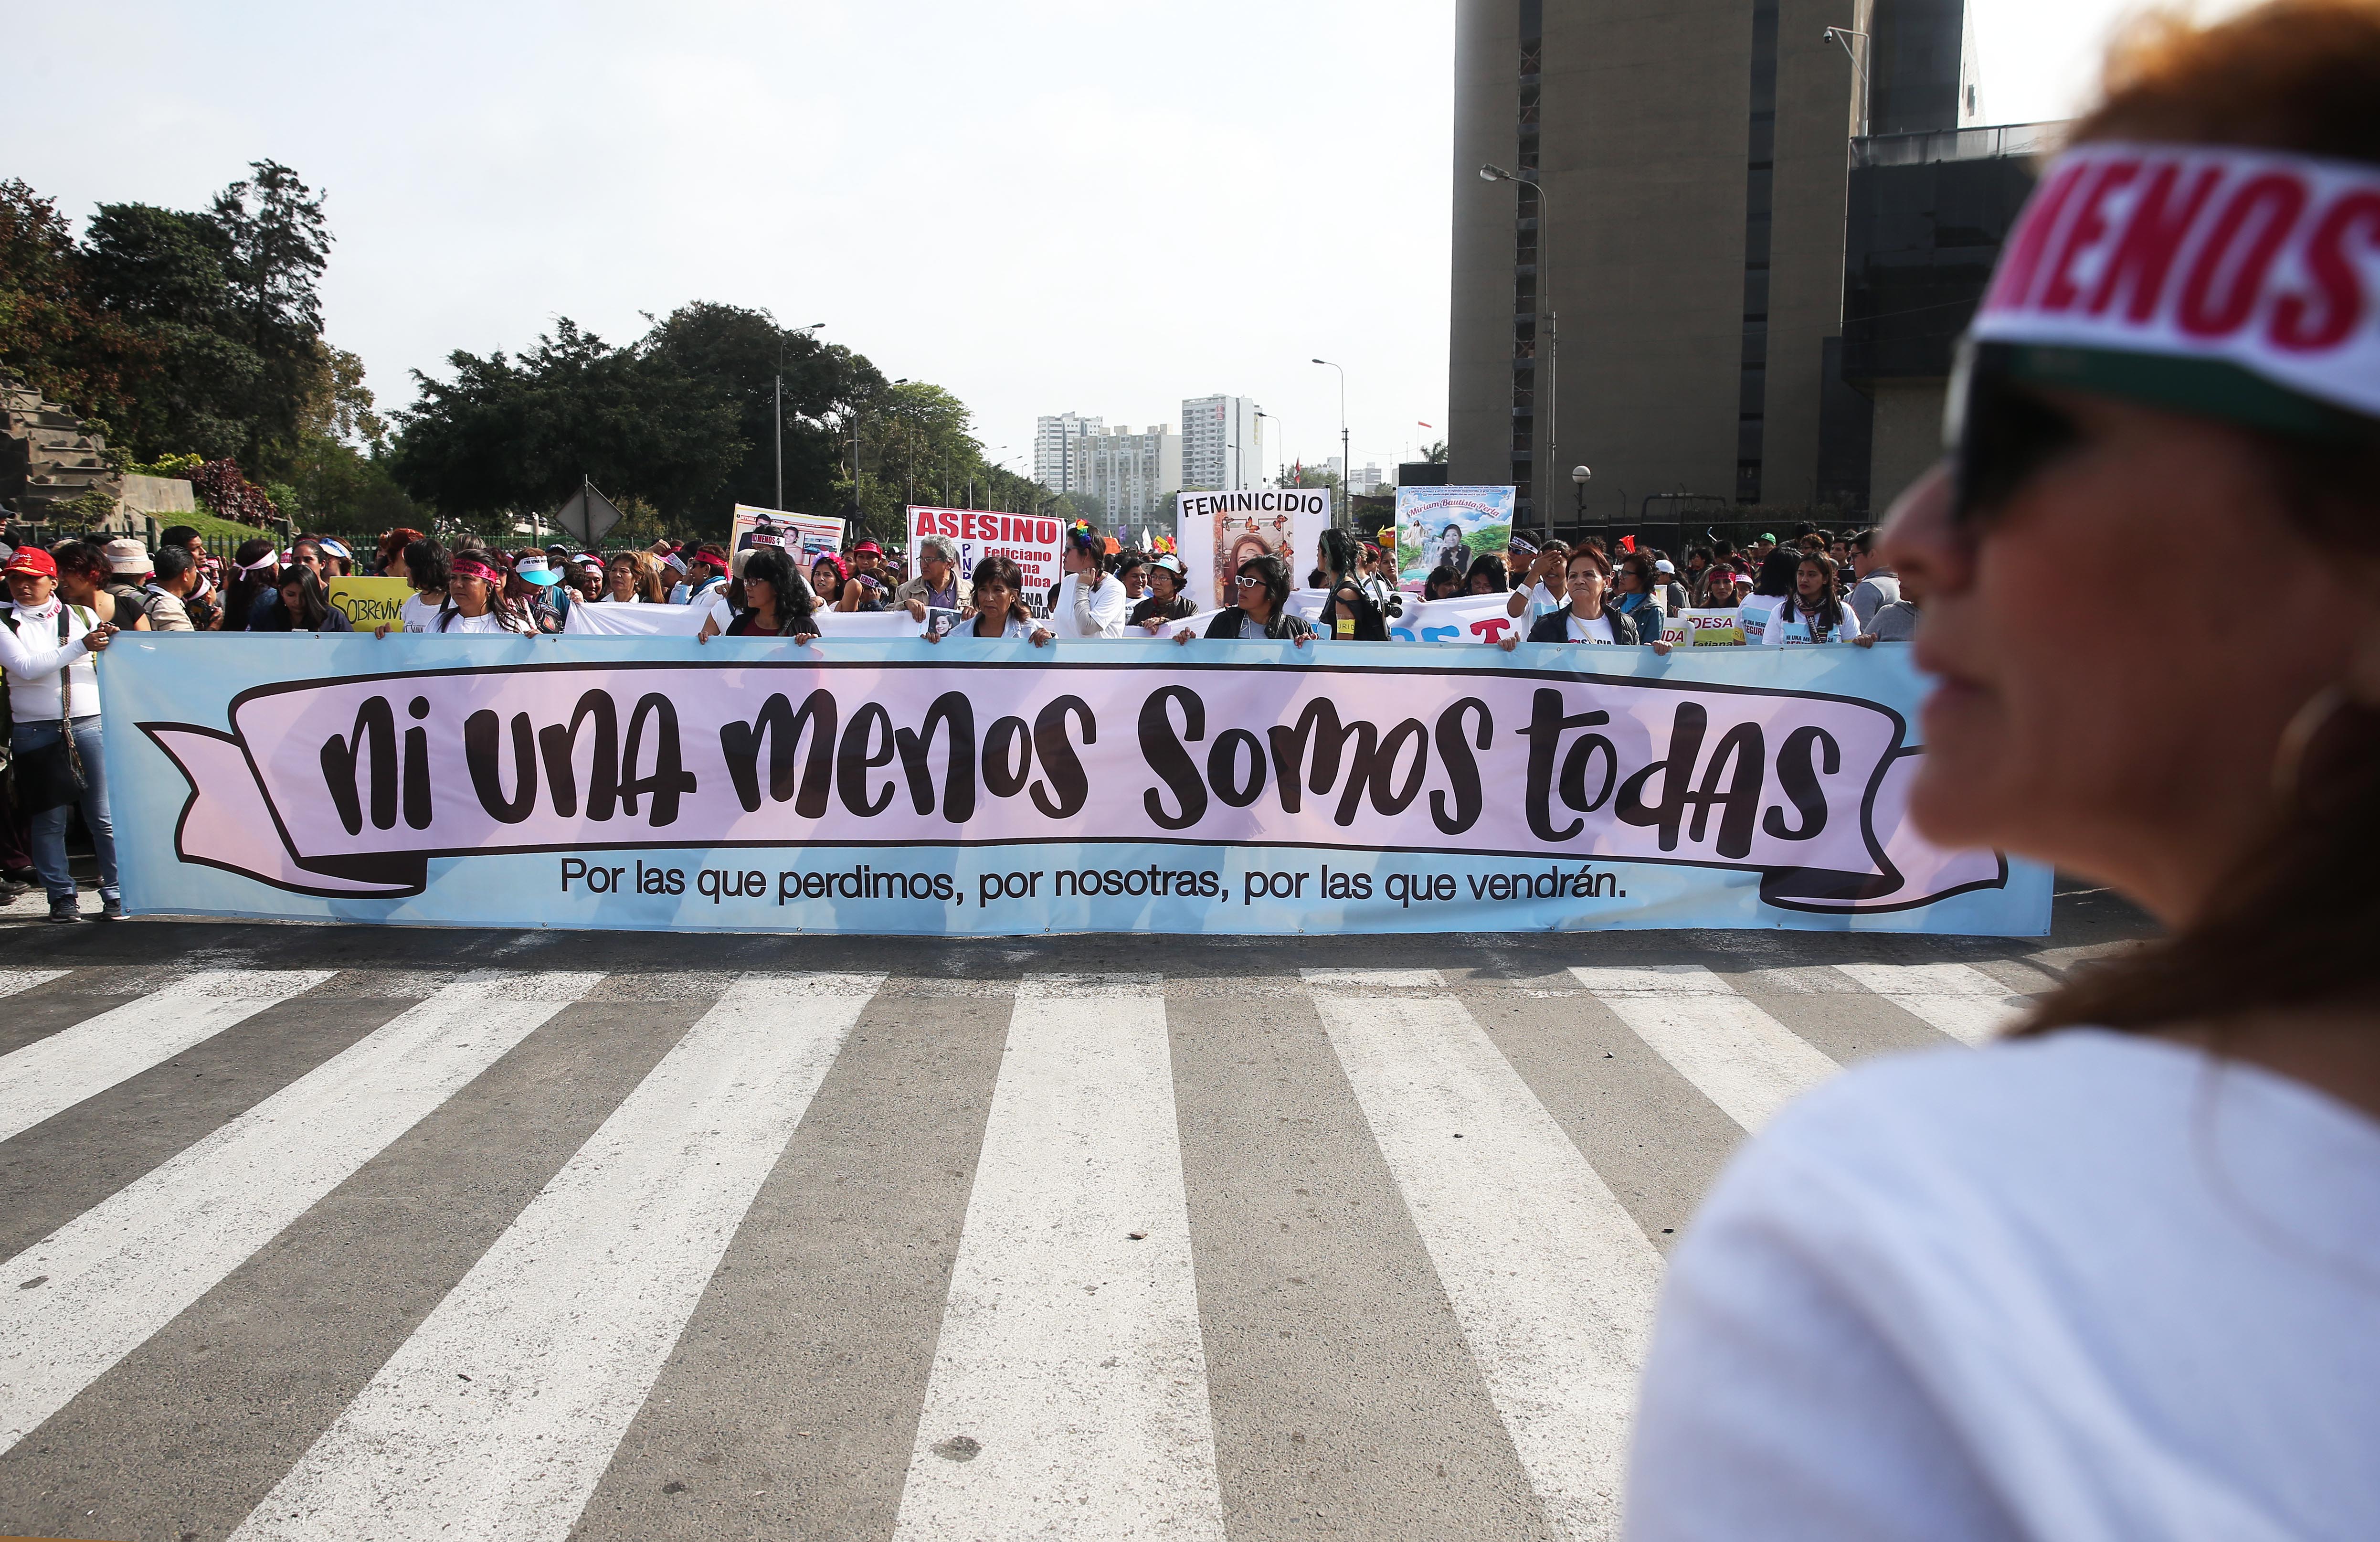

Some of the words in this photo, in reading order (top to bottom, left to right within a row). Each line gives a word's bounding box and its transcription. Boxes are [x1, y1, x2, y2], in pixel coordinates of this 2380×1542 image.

[1183, 493, 1323, 518] FEMINICIDIO
[1409, 501, 1439, 517] Miriam
[1441, 499, 1477, 508] Bautista
[1479, 503, 1500, 517] Perla
[916, 512, 1057, 544] ASESINO
[757, 535, 776, 544] MENOS
[984, 546, 1052, 562] Feliciano
[1661, 629, 1683, 643] IDA
[561, 858, 625, 893] Por
[636, 860, 685, 895] las
[697, 869, 766, 904] que
[779, 865, 963, 906] perdimos,
[980, 871, 1044, 908] por
[1056, 864, 1228, 903] nosotras,
[1244, 871, 1310, 905] por
[1321, 864, 1373, 900] las
[1385, 873, 1457, 908] que
[1466, 864, 1626, 900] vendrán.
